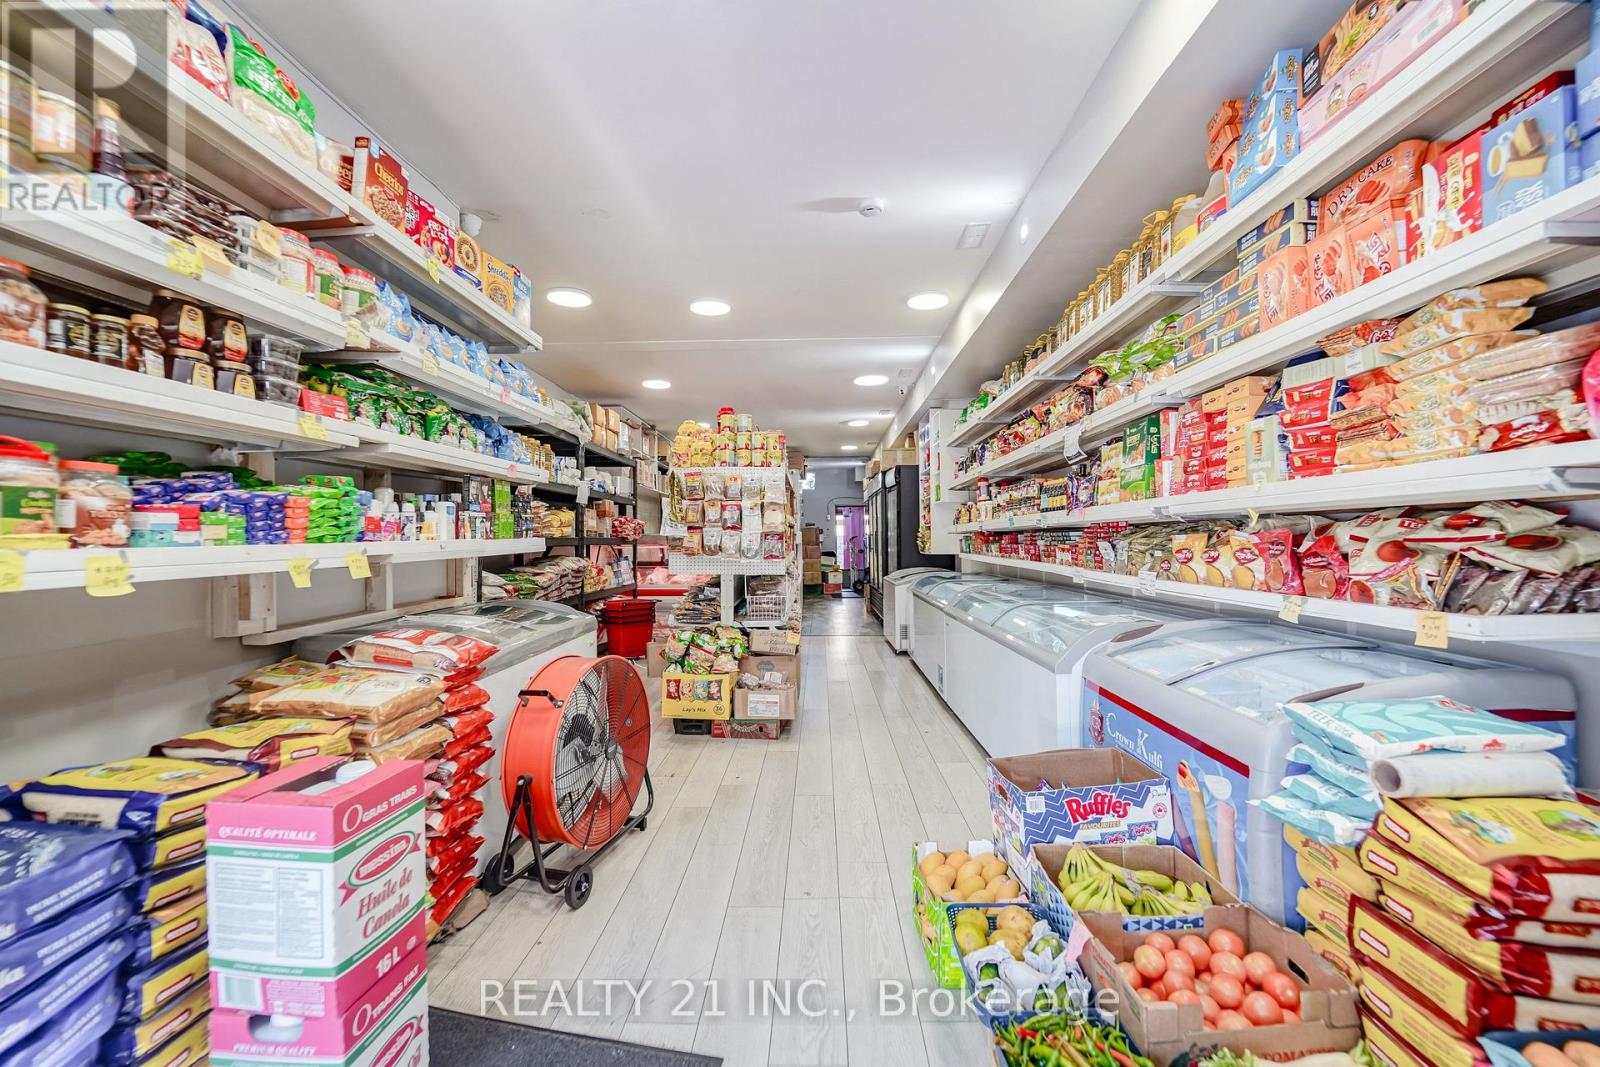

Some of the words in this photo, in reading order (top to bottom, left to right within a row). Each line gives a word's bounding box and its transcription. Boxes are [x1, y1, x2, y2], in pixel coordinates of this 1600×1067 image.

[374, 162, 404, 195] Cheerios
[1327, 180, 1356, 217] DRY
[1357, 155, 1393, 183] CAKE
[1106, 712, 1135, 750] Crown
[1137, 728, 1163, 770] Kulfi
[362, 801, 389, 822] GRAS
[389, 785, 418, 807] TRANS
[1065, 791, 1131, 824] Ruffles
[218, 825, 263, 838] QUALITÉ
[263, 828, 318, 841] OPTIMALE
[357, 878, 397, 921] Huile
[399, 867, 413, 887] de
[363, 892, 410, 938] Canola
[233, 1042, 274, 1055] PREMIUM
